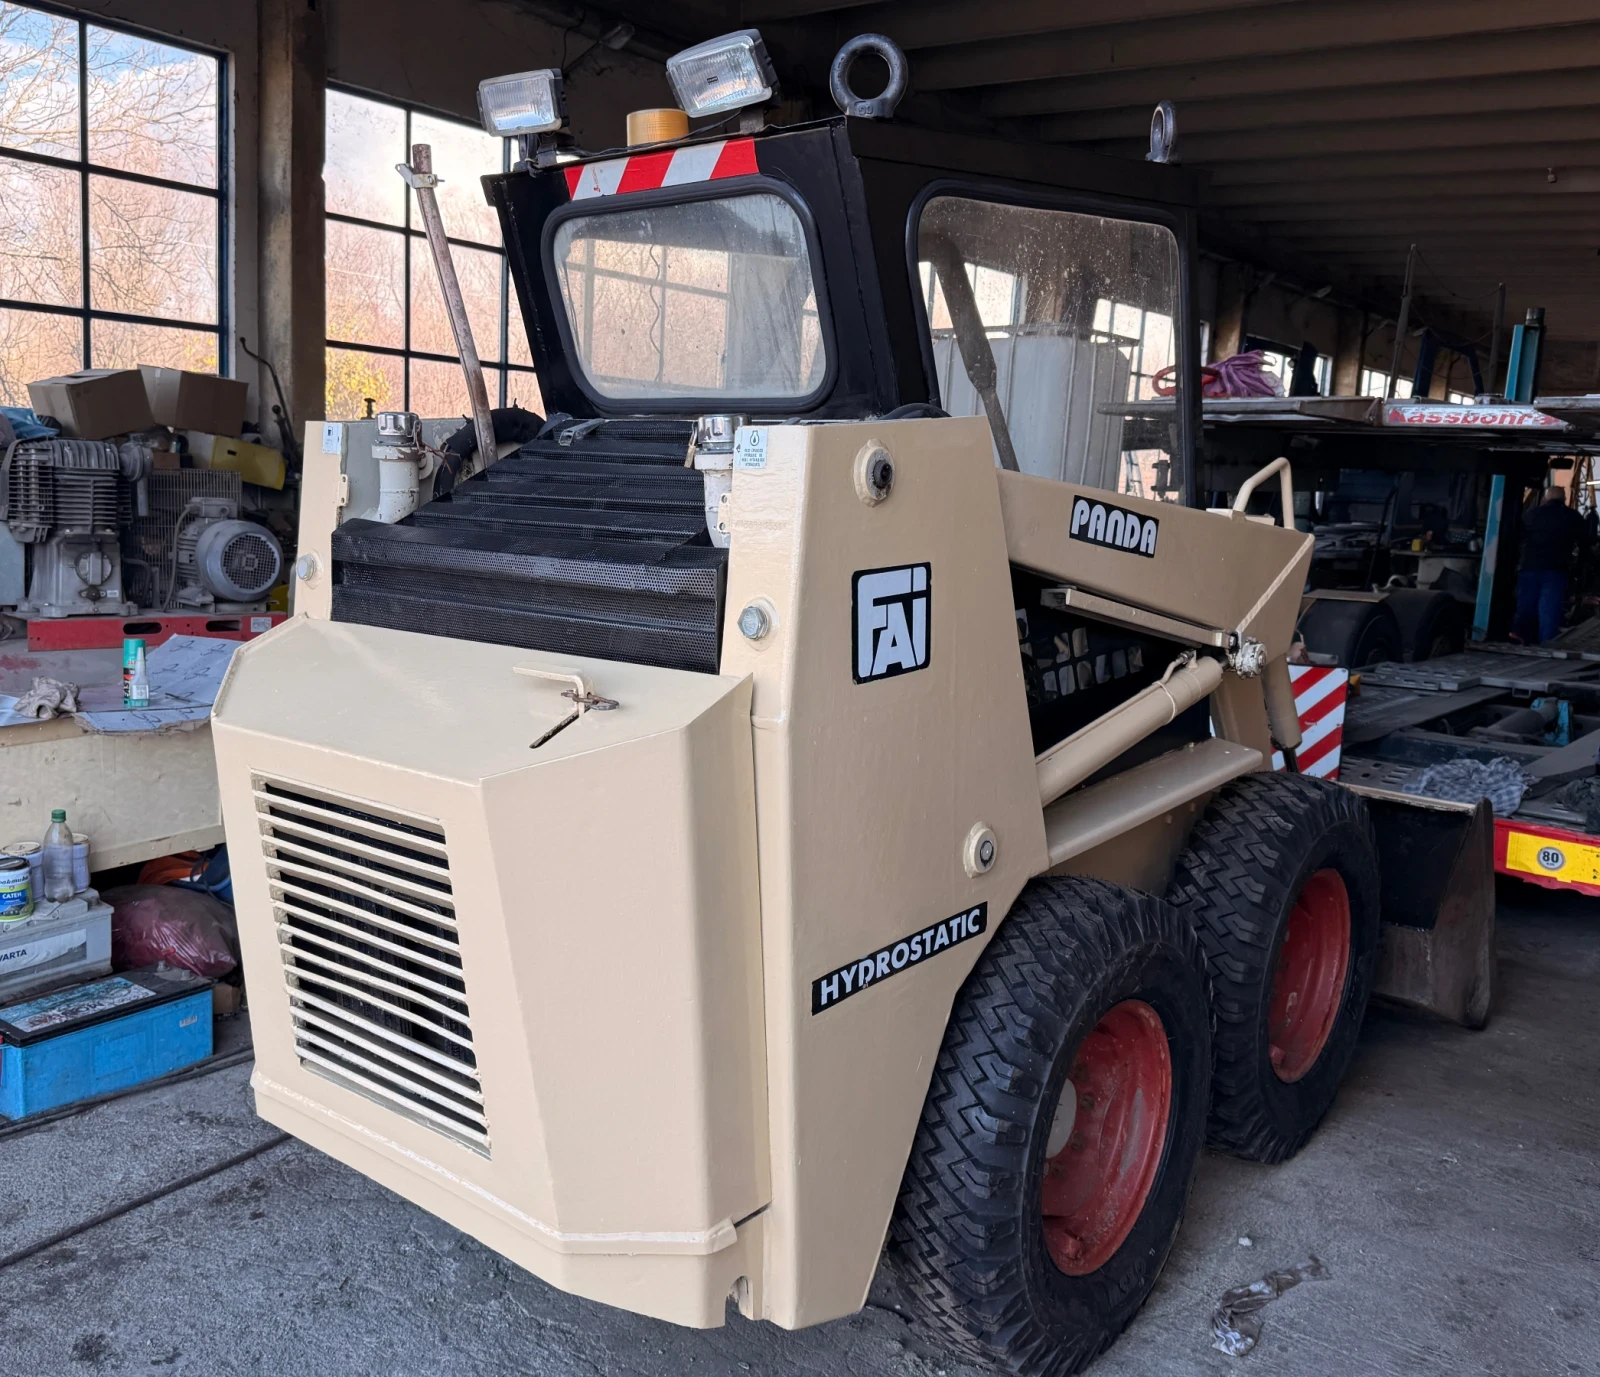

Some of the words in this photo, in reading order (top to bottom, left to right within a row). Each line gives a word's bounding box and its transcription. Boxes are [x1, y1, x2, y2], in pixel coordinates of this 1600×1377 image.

[1071, 499, 1157, 555] PANDA
[1542, 851, 1560, 863] 80
[820, 909, 981, 1006] HYDROSTATIC
